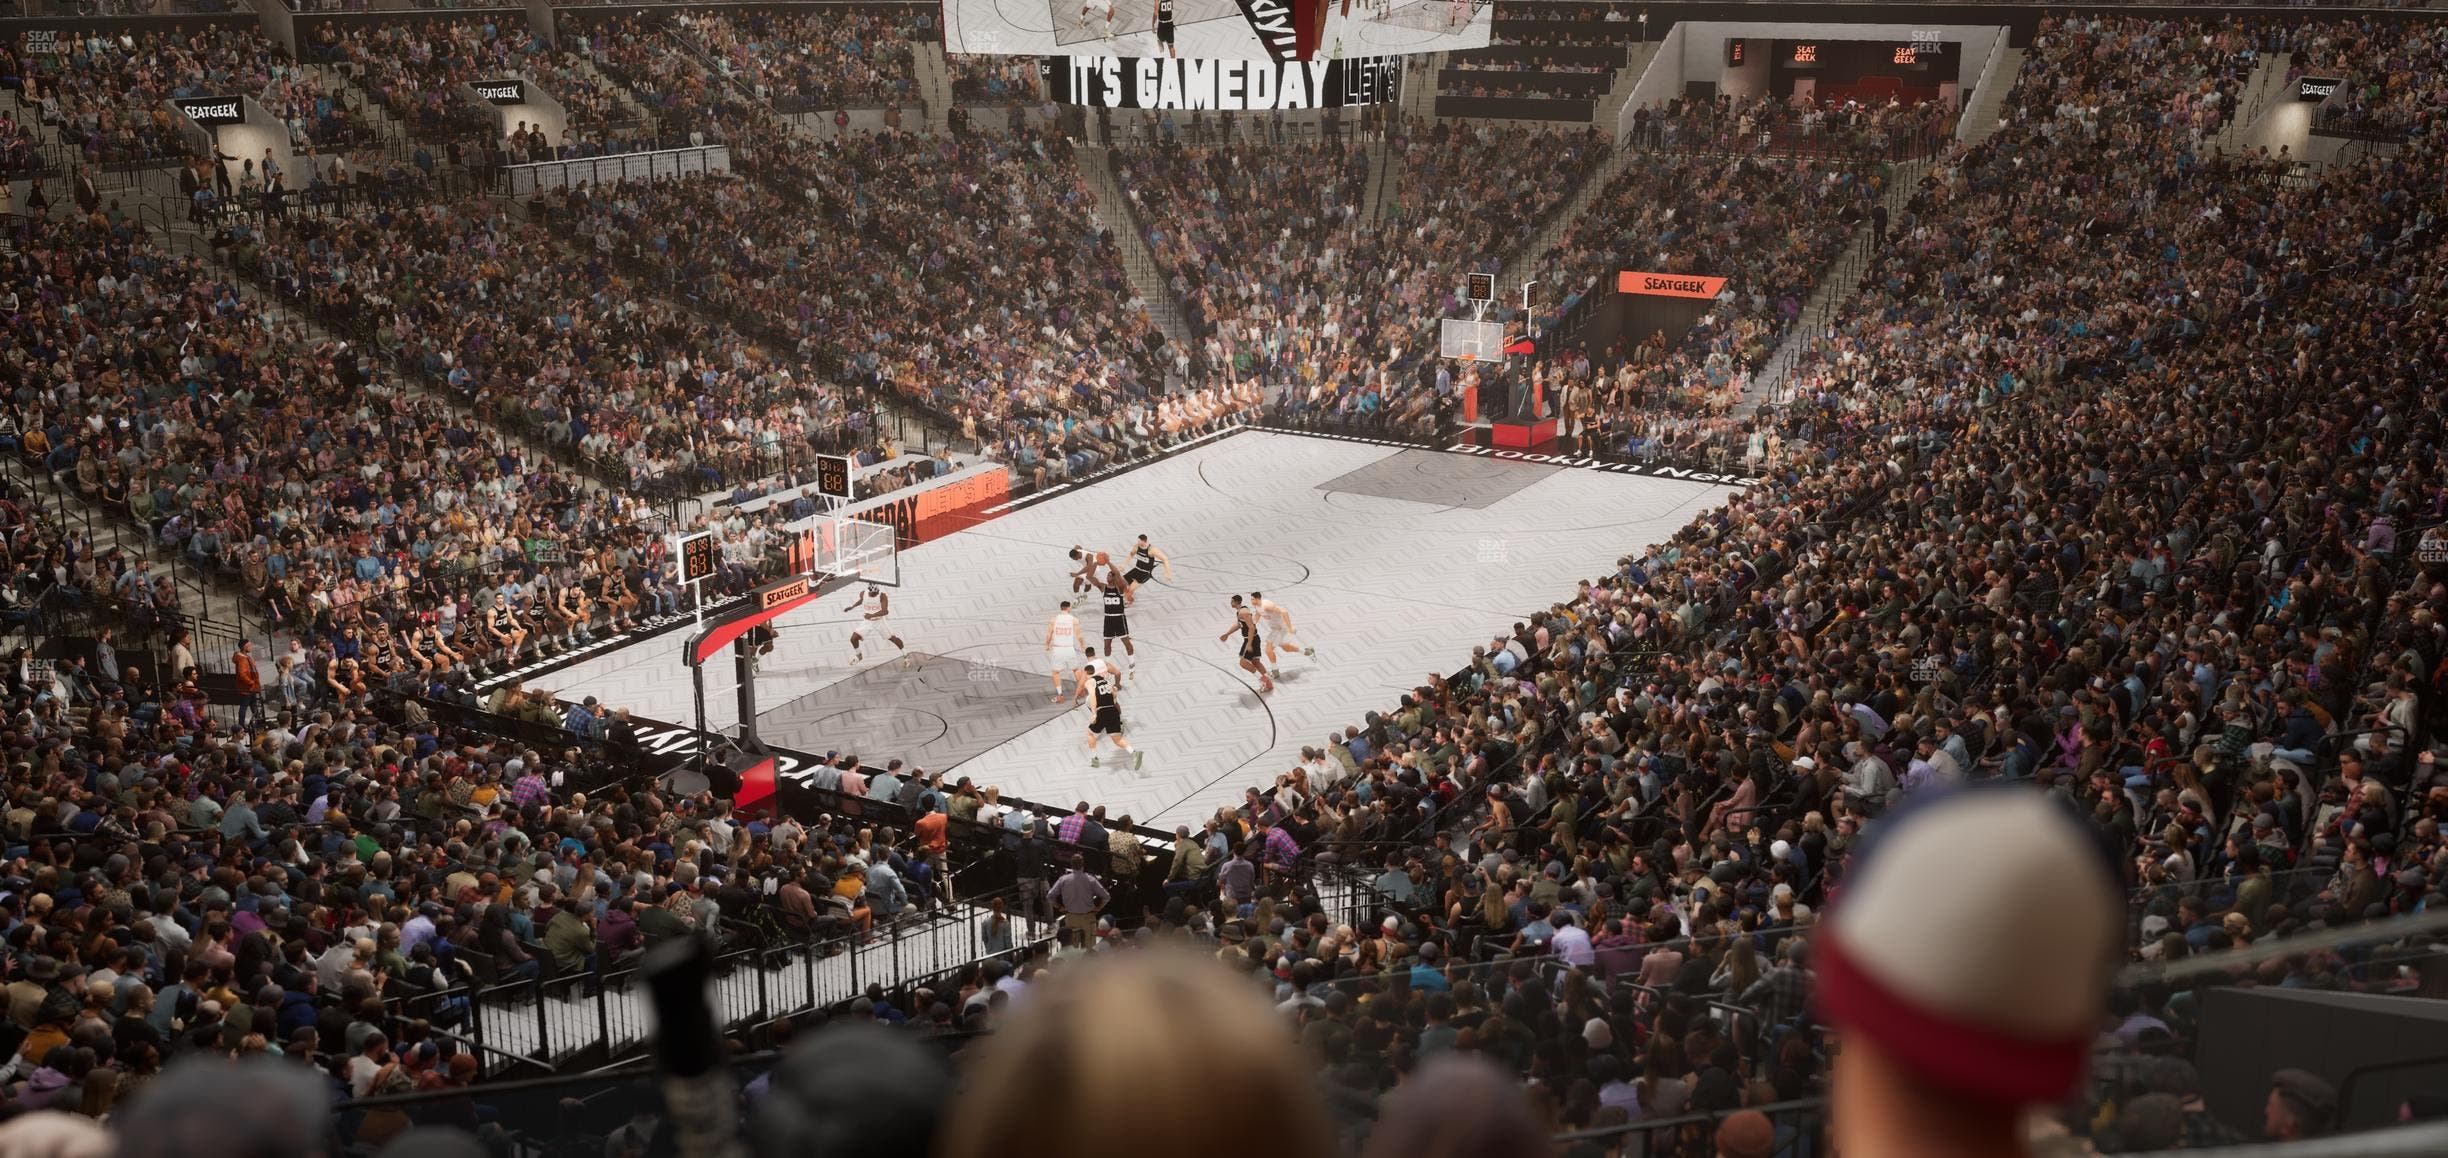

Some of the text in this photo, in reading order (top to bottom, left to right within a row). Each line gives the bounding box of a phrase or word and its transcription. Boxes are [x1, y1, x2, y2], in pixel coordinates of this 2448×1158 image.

[1796, 46, 1817, 54] SEAT
[1895, 48, 1916, 56] SEAT
[1794, 54, 1816, 62] GEEK
[1893, 56, 1916, 64] GEEK
[1069, 55, 1122, 107] IT'S
[1136, 57, 1330, 110] GAMEDAY
[477, 85, 520, 99] SEATGEEK
[184, 103, 238, 119] SEATGEEK
[1644, 277, 1706, 294] SEATGEEK
[1445, 443, 1763, 487] Brooklyn Nets
[767, 582, 804, 605] SEATGEEK
